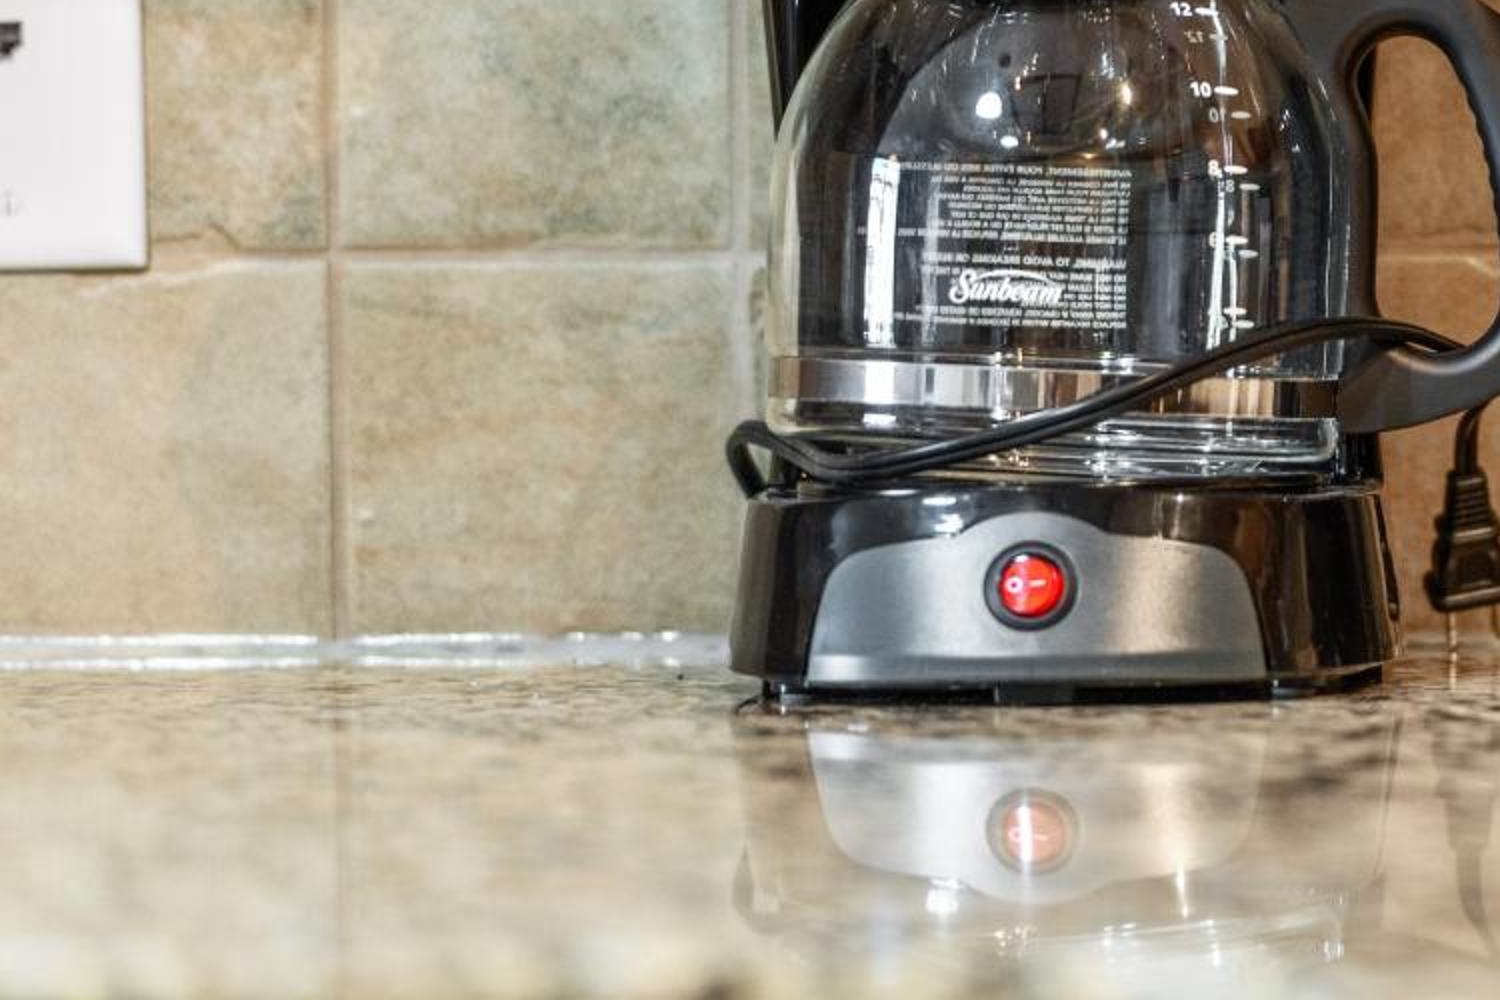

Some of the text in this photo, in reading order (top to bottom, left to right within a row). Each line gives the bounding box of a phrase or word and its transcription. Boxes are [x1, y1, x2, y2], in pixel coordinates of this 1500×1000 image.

[1170, 1, 1193, 17] 12
[1189, 81, 1212, 98] 10
[948, 269, 1064, 304] Sunbeam
